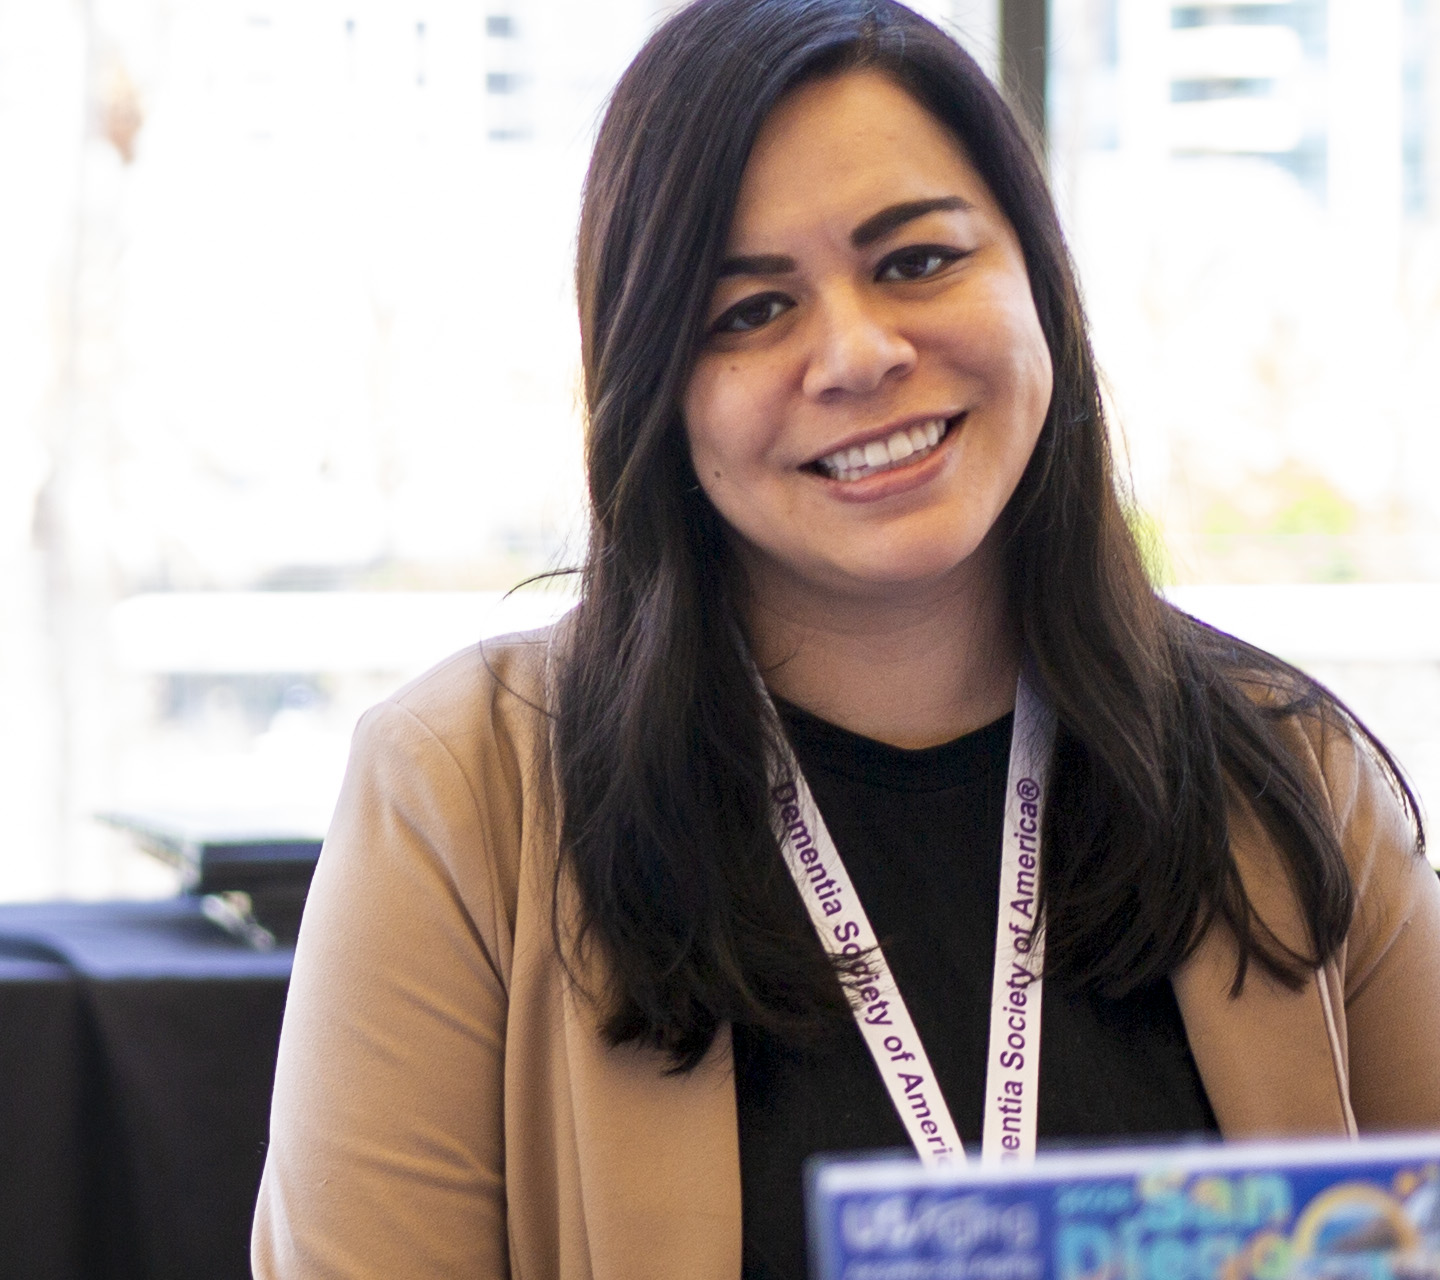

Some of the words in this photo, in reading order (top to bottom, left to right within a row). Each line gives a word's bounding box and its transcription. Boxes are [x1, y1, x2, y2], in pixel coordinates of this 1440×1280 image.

[771, 781, 843, 917] Dementia
[834, 921, 892, 1027] Society
[1008, 923, 1032, 954] of
[884, 1034, 915, 1064] of
[1000, 962, 1035, 1071] Society
[897, 1069, 953, 1162] Ameri
[998, 1080, 1023, 1162] entia
